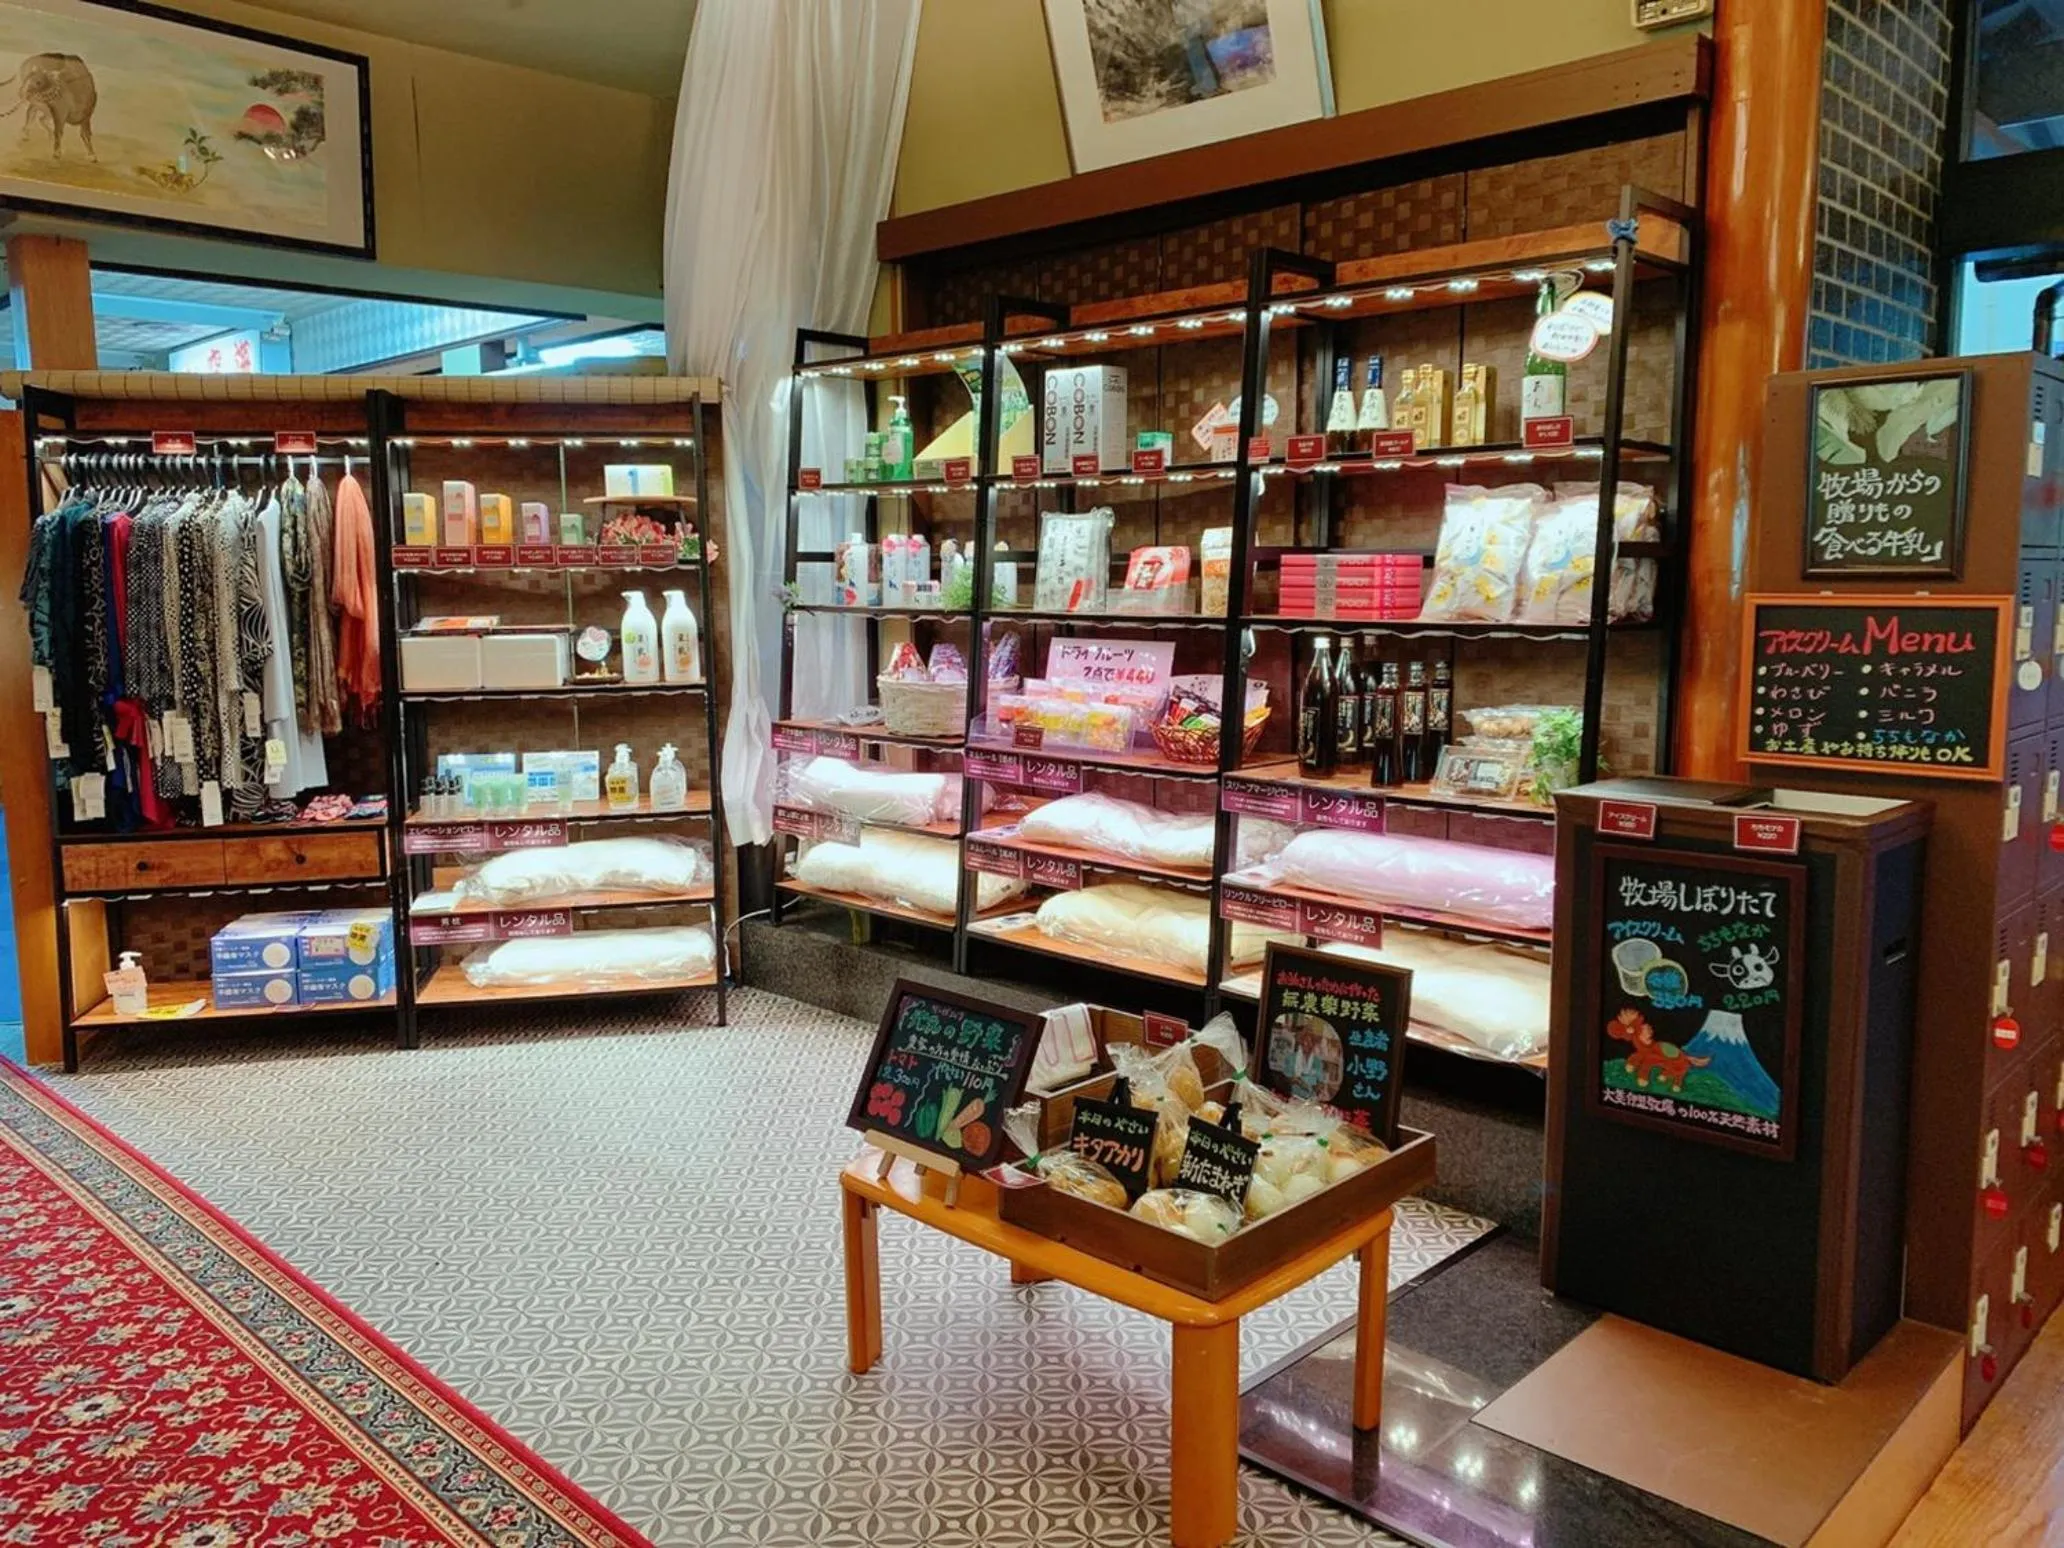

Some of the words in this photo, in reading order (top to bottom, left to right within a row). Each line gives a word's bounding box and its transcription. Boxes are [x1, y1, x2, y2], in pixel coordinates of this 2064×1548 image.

[1046, 375, 1058, 446] COBON
[1073, 372, 1085, 444] COBON
[1816, 467, 1941, 500] 牧場からの
[1826, 498, 1913, 525] 贈りもの
[1862, 615, 1976, 656] Menu
[1770, 662, 1844, 680] ブルーベリー
[1879, 661, 1963, 677] キャラメル
[1770, 685, 1831, 700] わさび
[1879, 684, 1938, 702] バニラ
[1771, 707, 1826, 721] メロン
[1878, 707, 1936, 725] ミルク
[1771, 720, 1822, 738] ゆず
[1026, 760, 1078, 780] レンタル品
[1308, 793, 1379, 819] レンタル品
[494, 822, 561, 838] レンタル品
[1026, 856, 1078, 878] レンタル品
[1618, 875, 1777, 918] 牧場しぼりたて
[499, 911, 566, 928] レンタル品
[1306, 905, 1377, 934] レンタル品
[1606, 919, 1685, 945] アイスクリーム
[1281, 988, 1381, 1023] 無農薬野菜
[1723, 989, 1780, 1010] 220円
[888, 1049, 920, 1070] トマト
[1346, 1054, 1389, 1081] 小野
[1352, 1081, 1381, 1100] さん
[1077, 1108, 1150, 1136] 本日のやさい
[1073, 1131, 1145, 1173] キタアカリ
[1188, 1129, 1253, 1166] 本日のやさい
[1179, 1150, 1250, 1201] 新たまねぎ
